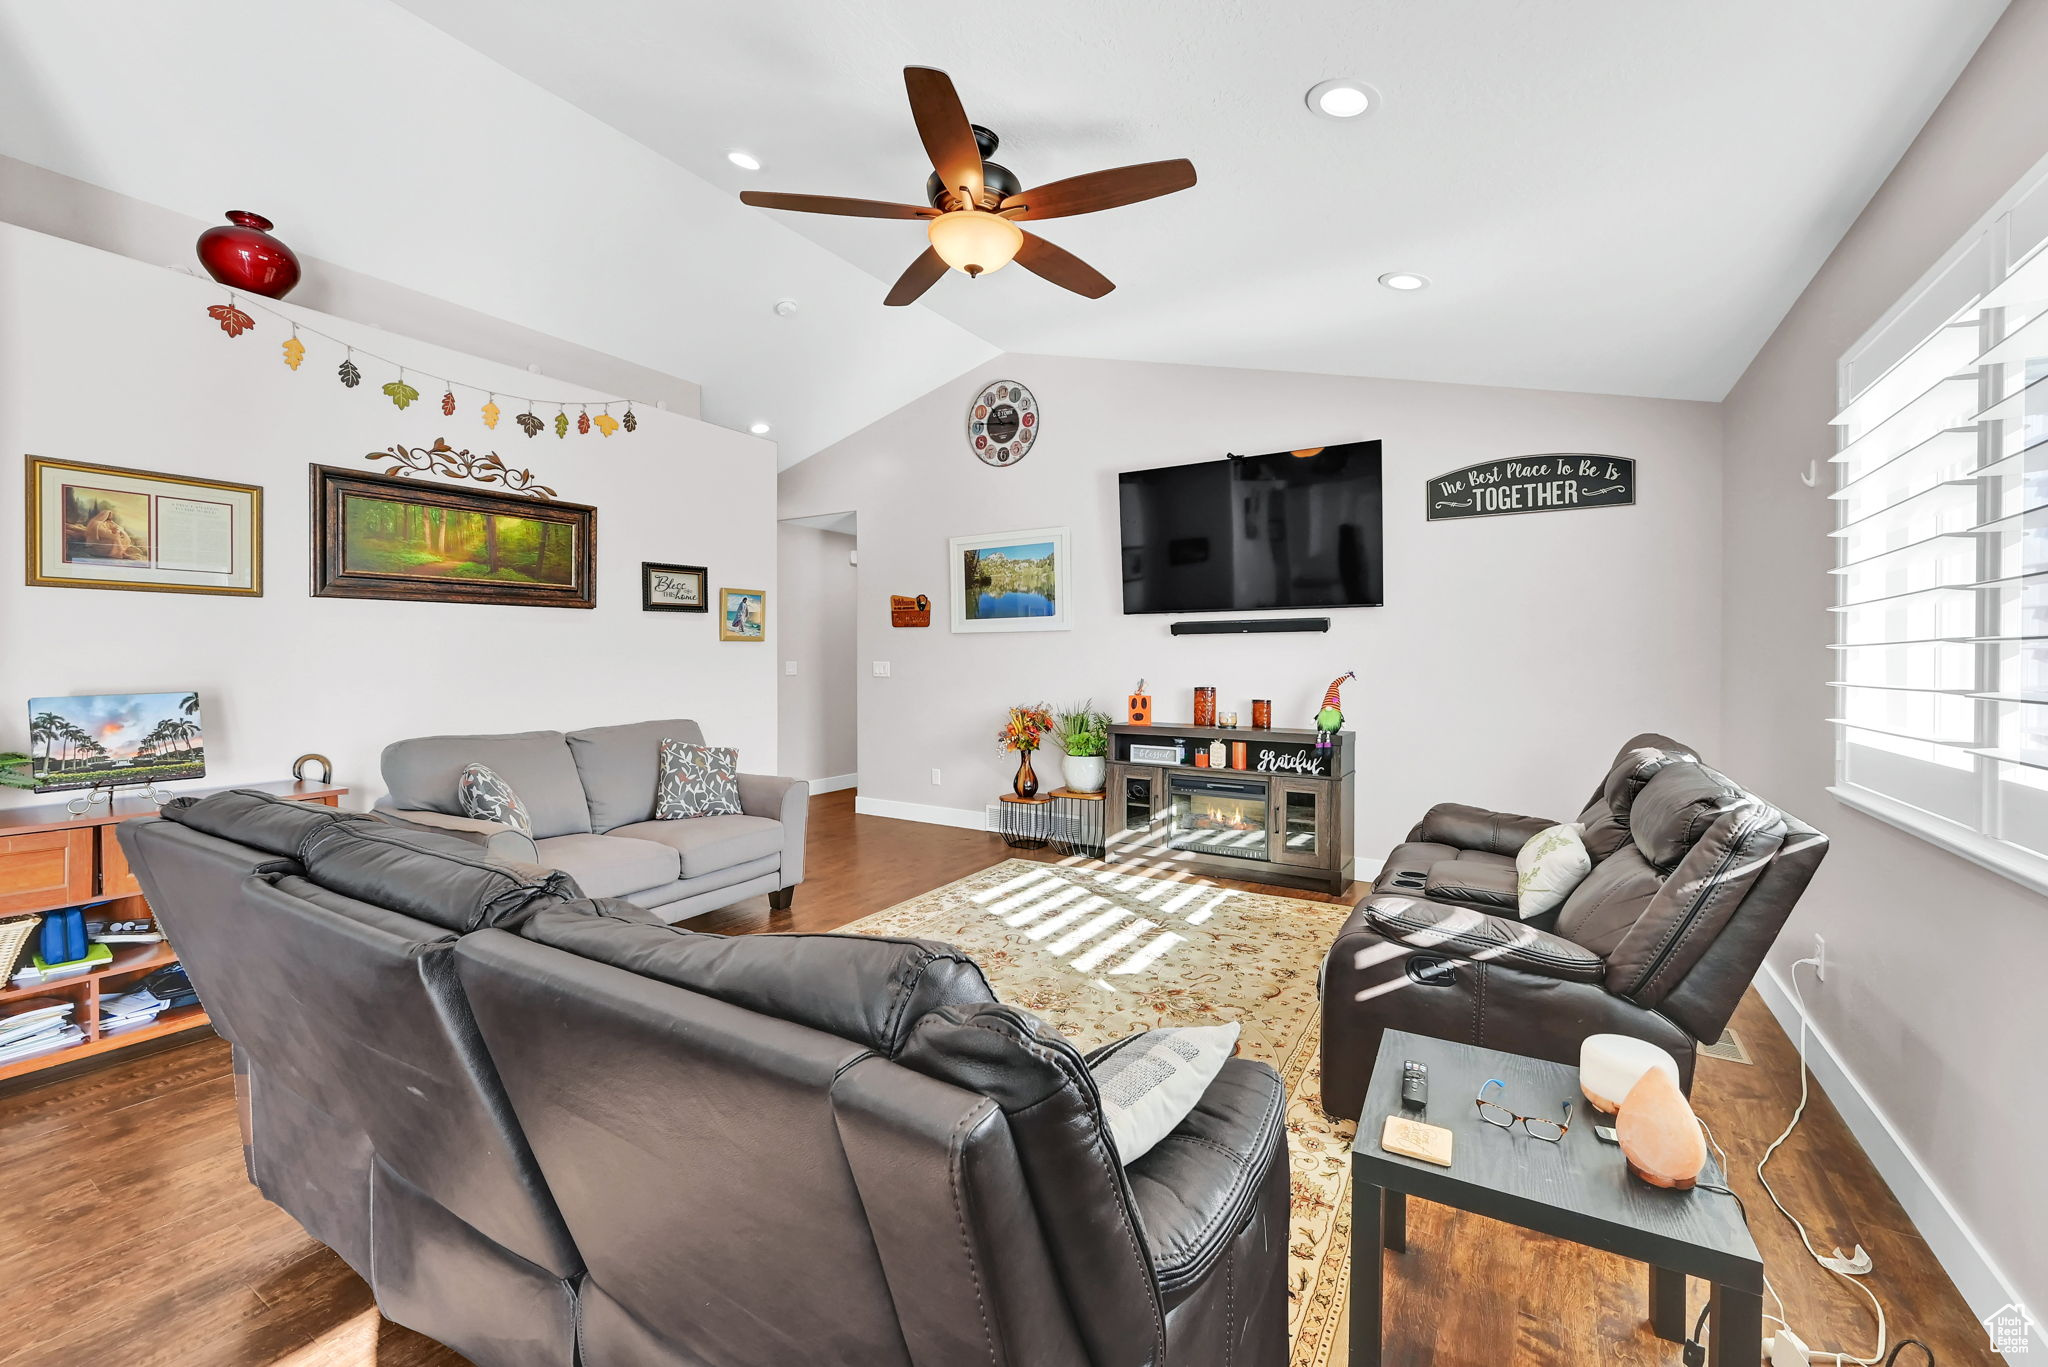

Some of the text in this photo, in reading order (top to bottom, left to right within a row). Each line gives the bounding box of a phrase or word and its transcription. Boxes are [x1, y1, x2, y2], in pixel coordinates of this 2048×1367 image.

[1438, 458, 1621, 497] The Best Place To Be Is
[1472, 480, 1578, 511] TOGETHER
[655, 575, 686, 592] Bless
[675, 590, 697, 600] home
[1139, 749, 1170, 759] blessed
[1257, 749, 1325, 775] grateful
